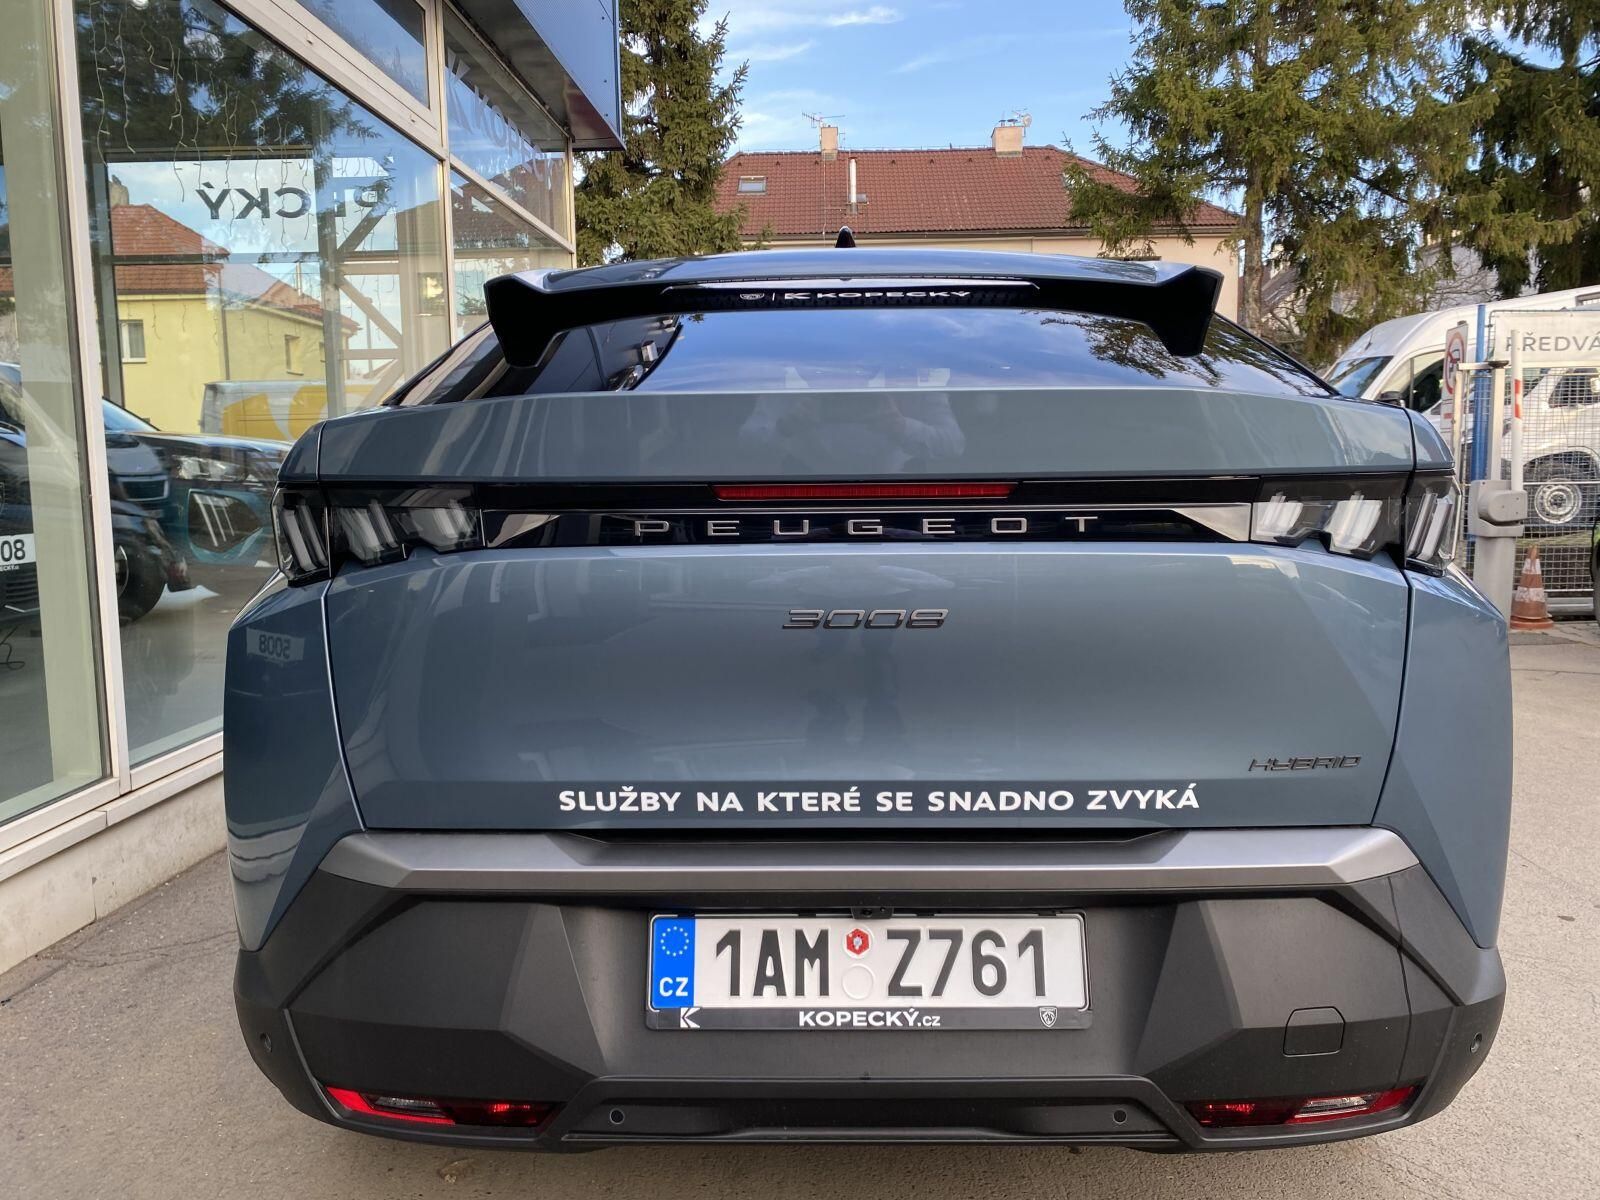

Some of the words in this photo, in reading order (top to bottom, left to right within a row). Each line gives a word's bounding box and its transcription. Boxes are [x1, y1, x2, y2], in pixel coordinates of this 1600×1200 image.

[633, 516, 1099, 537] PEUGEOT
[782, 608, 950, 630] 3008
[1247, 756, 1362, 772] HYBRID
[559, 786, 681, 812] SLUŽBY
[697, 791, 744, 812] NA
[757, 786, 861, 812] KTERÉ
[876, 791, 913, 812] SE
[928, 790, 1074, 812] SNADNO
[1087, 783, 1200, 811] ZVYKÁ
[715, 928, 830, 997] 1AM
[887, 928, 1047, 997] Z761
[659, 976, 689, 998] CZ
[799, 1008, 941, 1027] KOPECKÝ.cz
